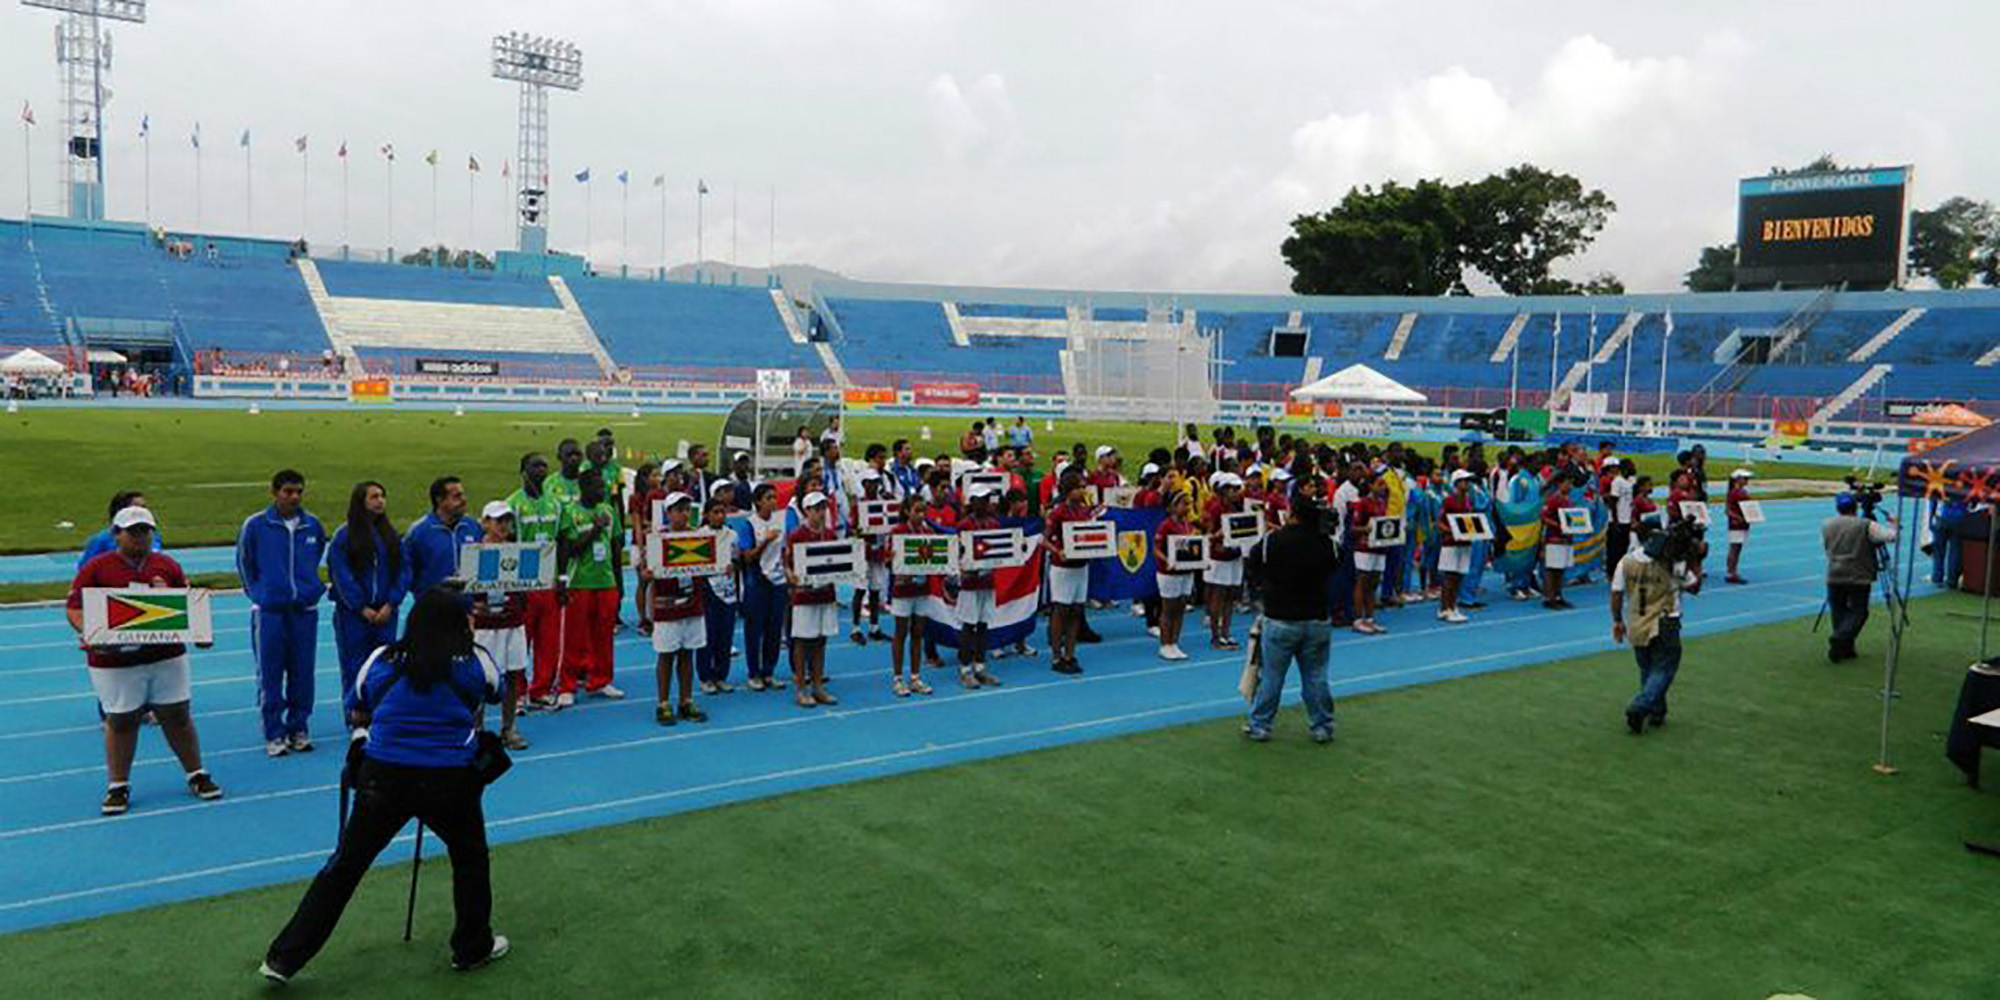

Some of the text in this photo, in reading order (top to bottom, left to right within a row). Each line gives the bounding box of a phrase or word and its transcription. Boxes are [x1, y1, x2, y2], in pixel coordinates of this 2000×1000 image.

[1770, 173, 1873, 192] POWERADE
[1762, 215, 1874, 241] BIENVENIDOS
[471, 580, 543, 592] GUATEMALA
[117, 631, 181, 642] GUYANA
